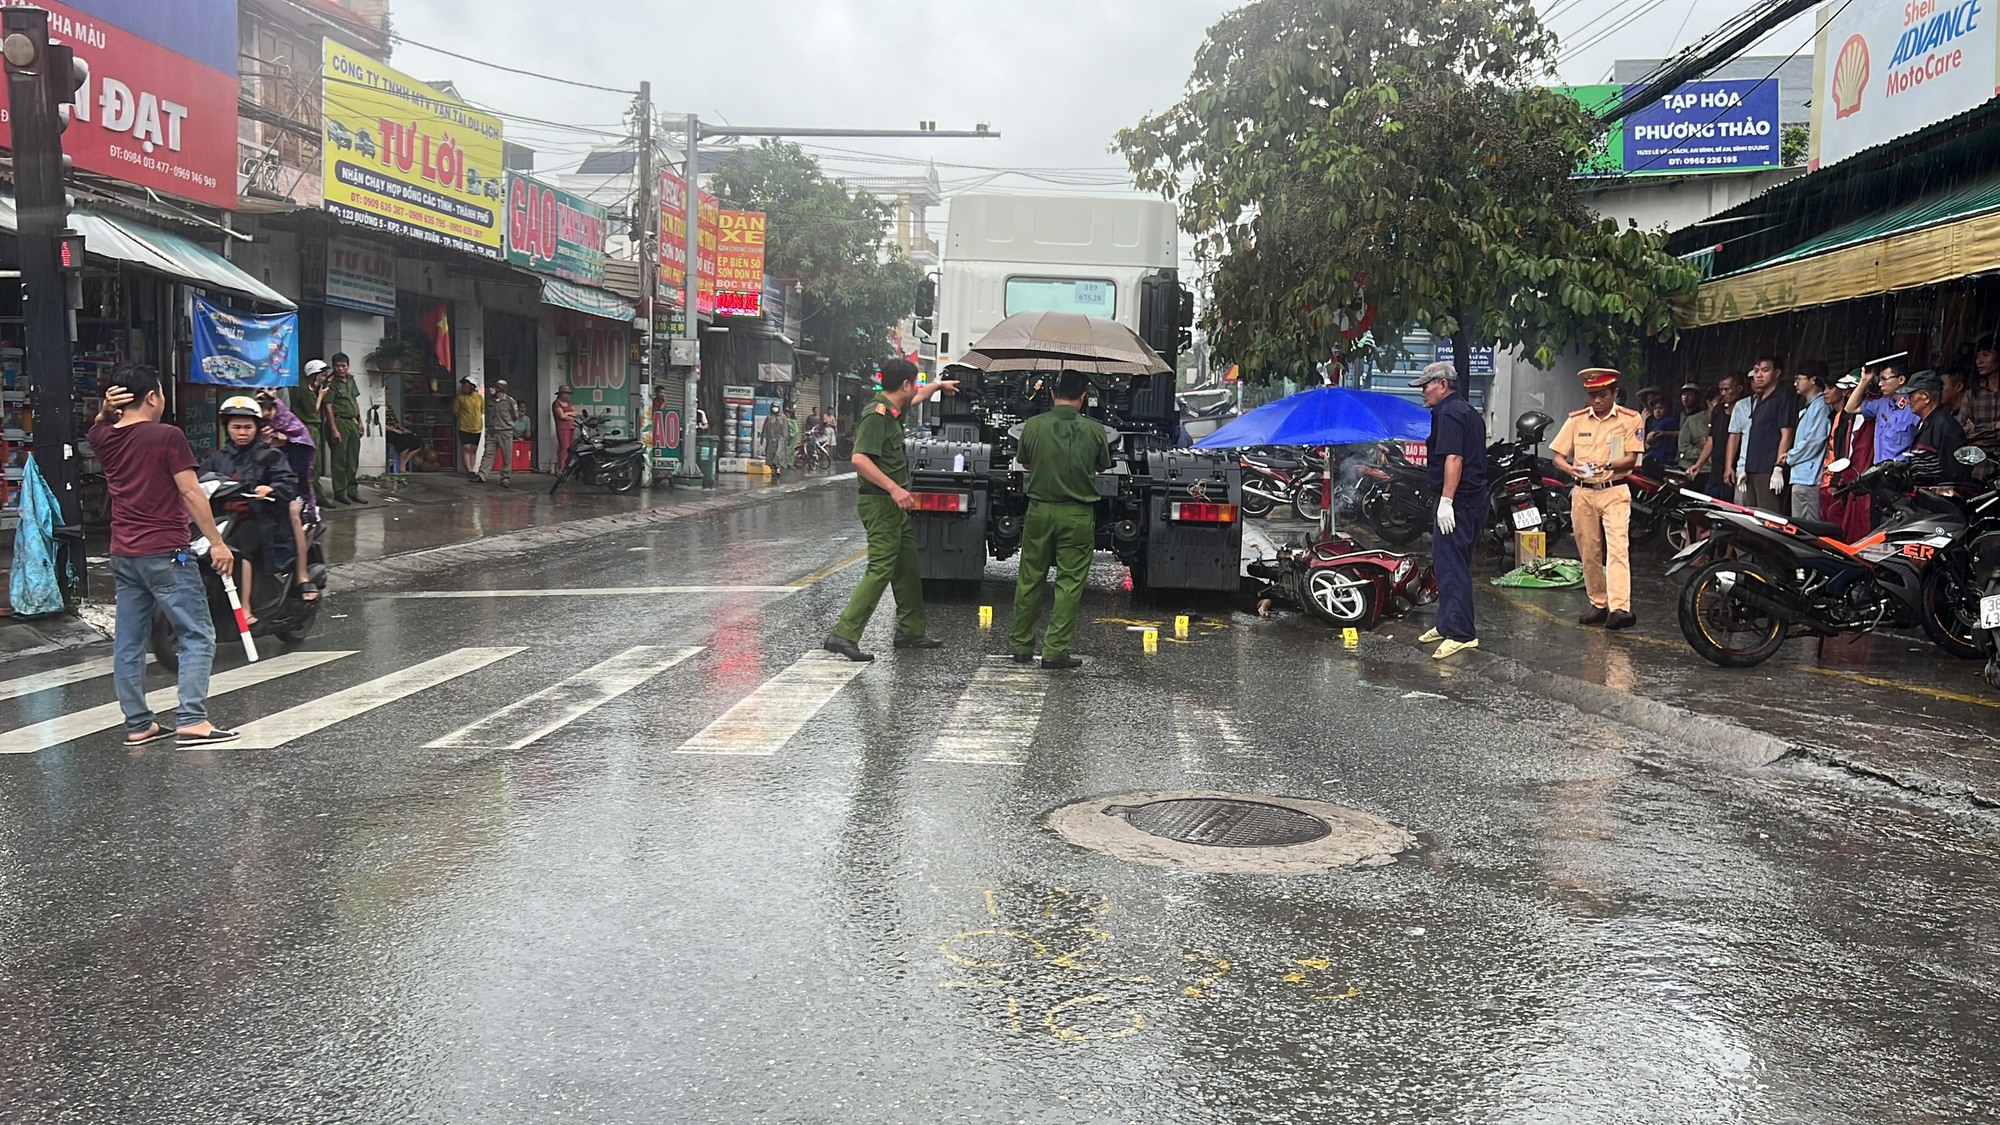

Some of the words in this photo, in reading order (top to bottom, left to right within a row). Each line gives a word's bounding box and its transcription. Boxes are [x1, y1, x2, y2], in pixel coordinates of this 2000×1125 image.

[75, 22, 106, 49] MÀU
[1888, 0, 1981, 70] ADVANCE
[1886, 48, 1962, 98] MotoCare
[332, 55, 363, 80] CÔNG
[366, 70, 380, 85] TY
[468, 117, 480, 132] DU
[481, 124, 499, 140] LỊCH
[1661, 94, 1698, 114] TẠP
[1701, 89, 1743, 108] HÓA
[99, 77, 188, 153] ĐẠT
[1634, 120, 1715, 140] PHƯƠNG
[1718, 116, 1771, 138] THẢO
[110, 145, 123, 160] ĐT:
[123, 150, 142, 166] 0984
[143, 156, 155, 170] 013
[156, 160, 169, 174] 477
[173, 167, 191, 182] 0969
[191, 171, 204, 185] 146
[204, 174, 216, 189] 949
[378, 117, 417, 173] TƯ
[421, 130, 464, 193] LỜI
[1706, 156, 1722, 164] 226
[341, 166, 364, 186] NHẬN
[365, 174, 385, 192] CHẠY
[386, 181, 401, 197] HỢP
[351, 192, 363, 204] ĐT:
[342, 209, 354, 221] 123
[378, 219, 384, 228] 5
[387, 220, 400, 233] KP2
[509, 176, 556, 266] GẠO
[719, 212, 765, 230] DÁN
[720, 228, 764, 245] XE
[716, 280, 738, 289] BỌC
[741, 281, 762, 290] YÊN
[752, 270, 762, 279] XE
[1752, 277, 1799, 311] XE
[571, 327, 626, 402] GẠO
[651, 410, 680, 457] ẠO
